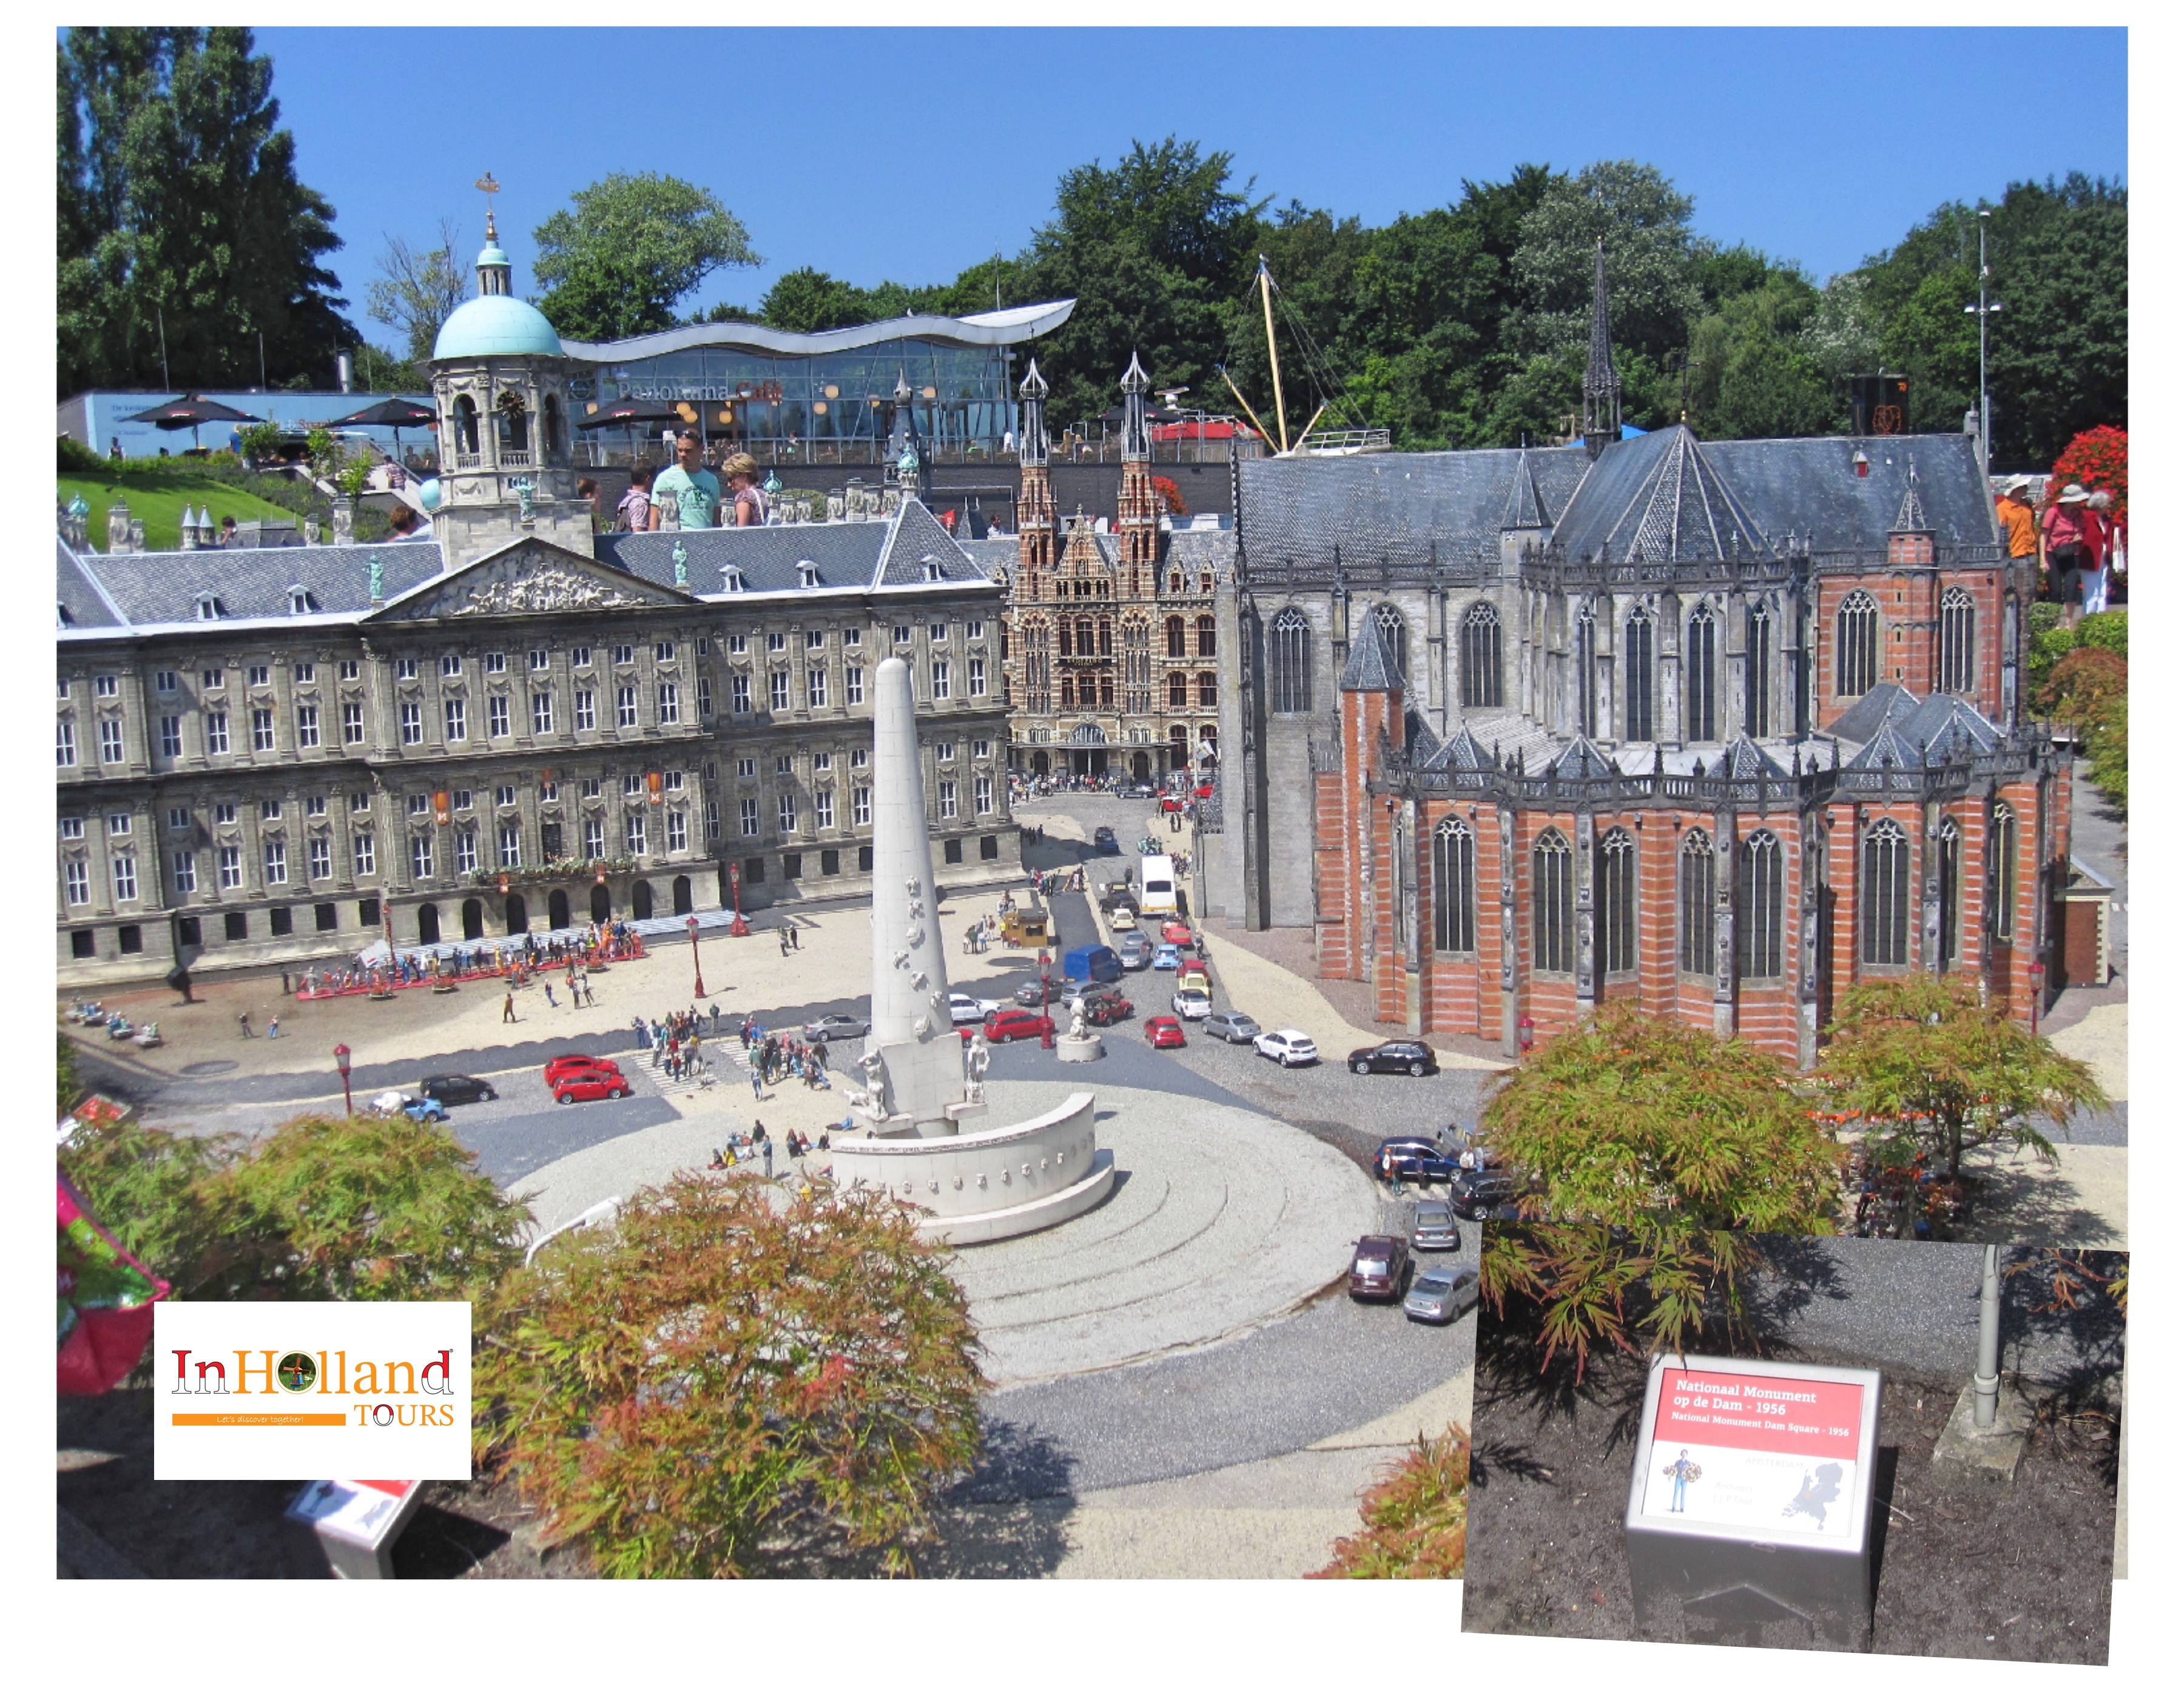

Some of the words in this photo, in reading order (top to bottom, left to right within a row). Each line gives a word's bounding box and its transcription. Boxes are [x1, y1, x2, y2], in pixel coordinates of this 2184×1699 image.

[616, 380, 729, 400] Panorama
[1676, 1380, 1739, 1396] Nationaal
[1744, 1386, 1816, 1403] Monument
[1674, 1396, 1690, 1408] op
[1693, 1396, 1708, 1408] de
[1712, 1398, 1742, 1411] Dam
[1756, 1402, 1786, 1415] 1956
[1671, 1412, 1710, 1423] National
[1713, 1416, 1762, 1428] Monument
[1764, 1420, 1785, 1430] Dam
[1787, 1423, 1819, 1434] Square
[1828, 1427, 1849, 1437] 1956
[1745, 1457, 1804, 1469] AMSTERDAM
[1715, 1481, 1753, 1493] Architect
[1734, 1496, 1753, 1505] Oud
